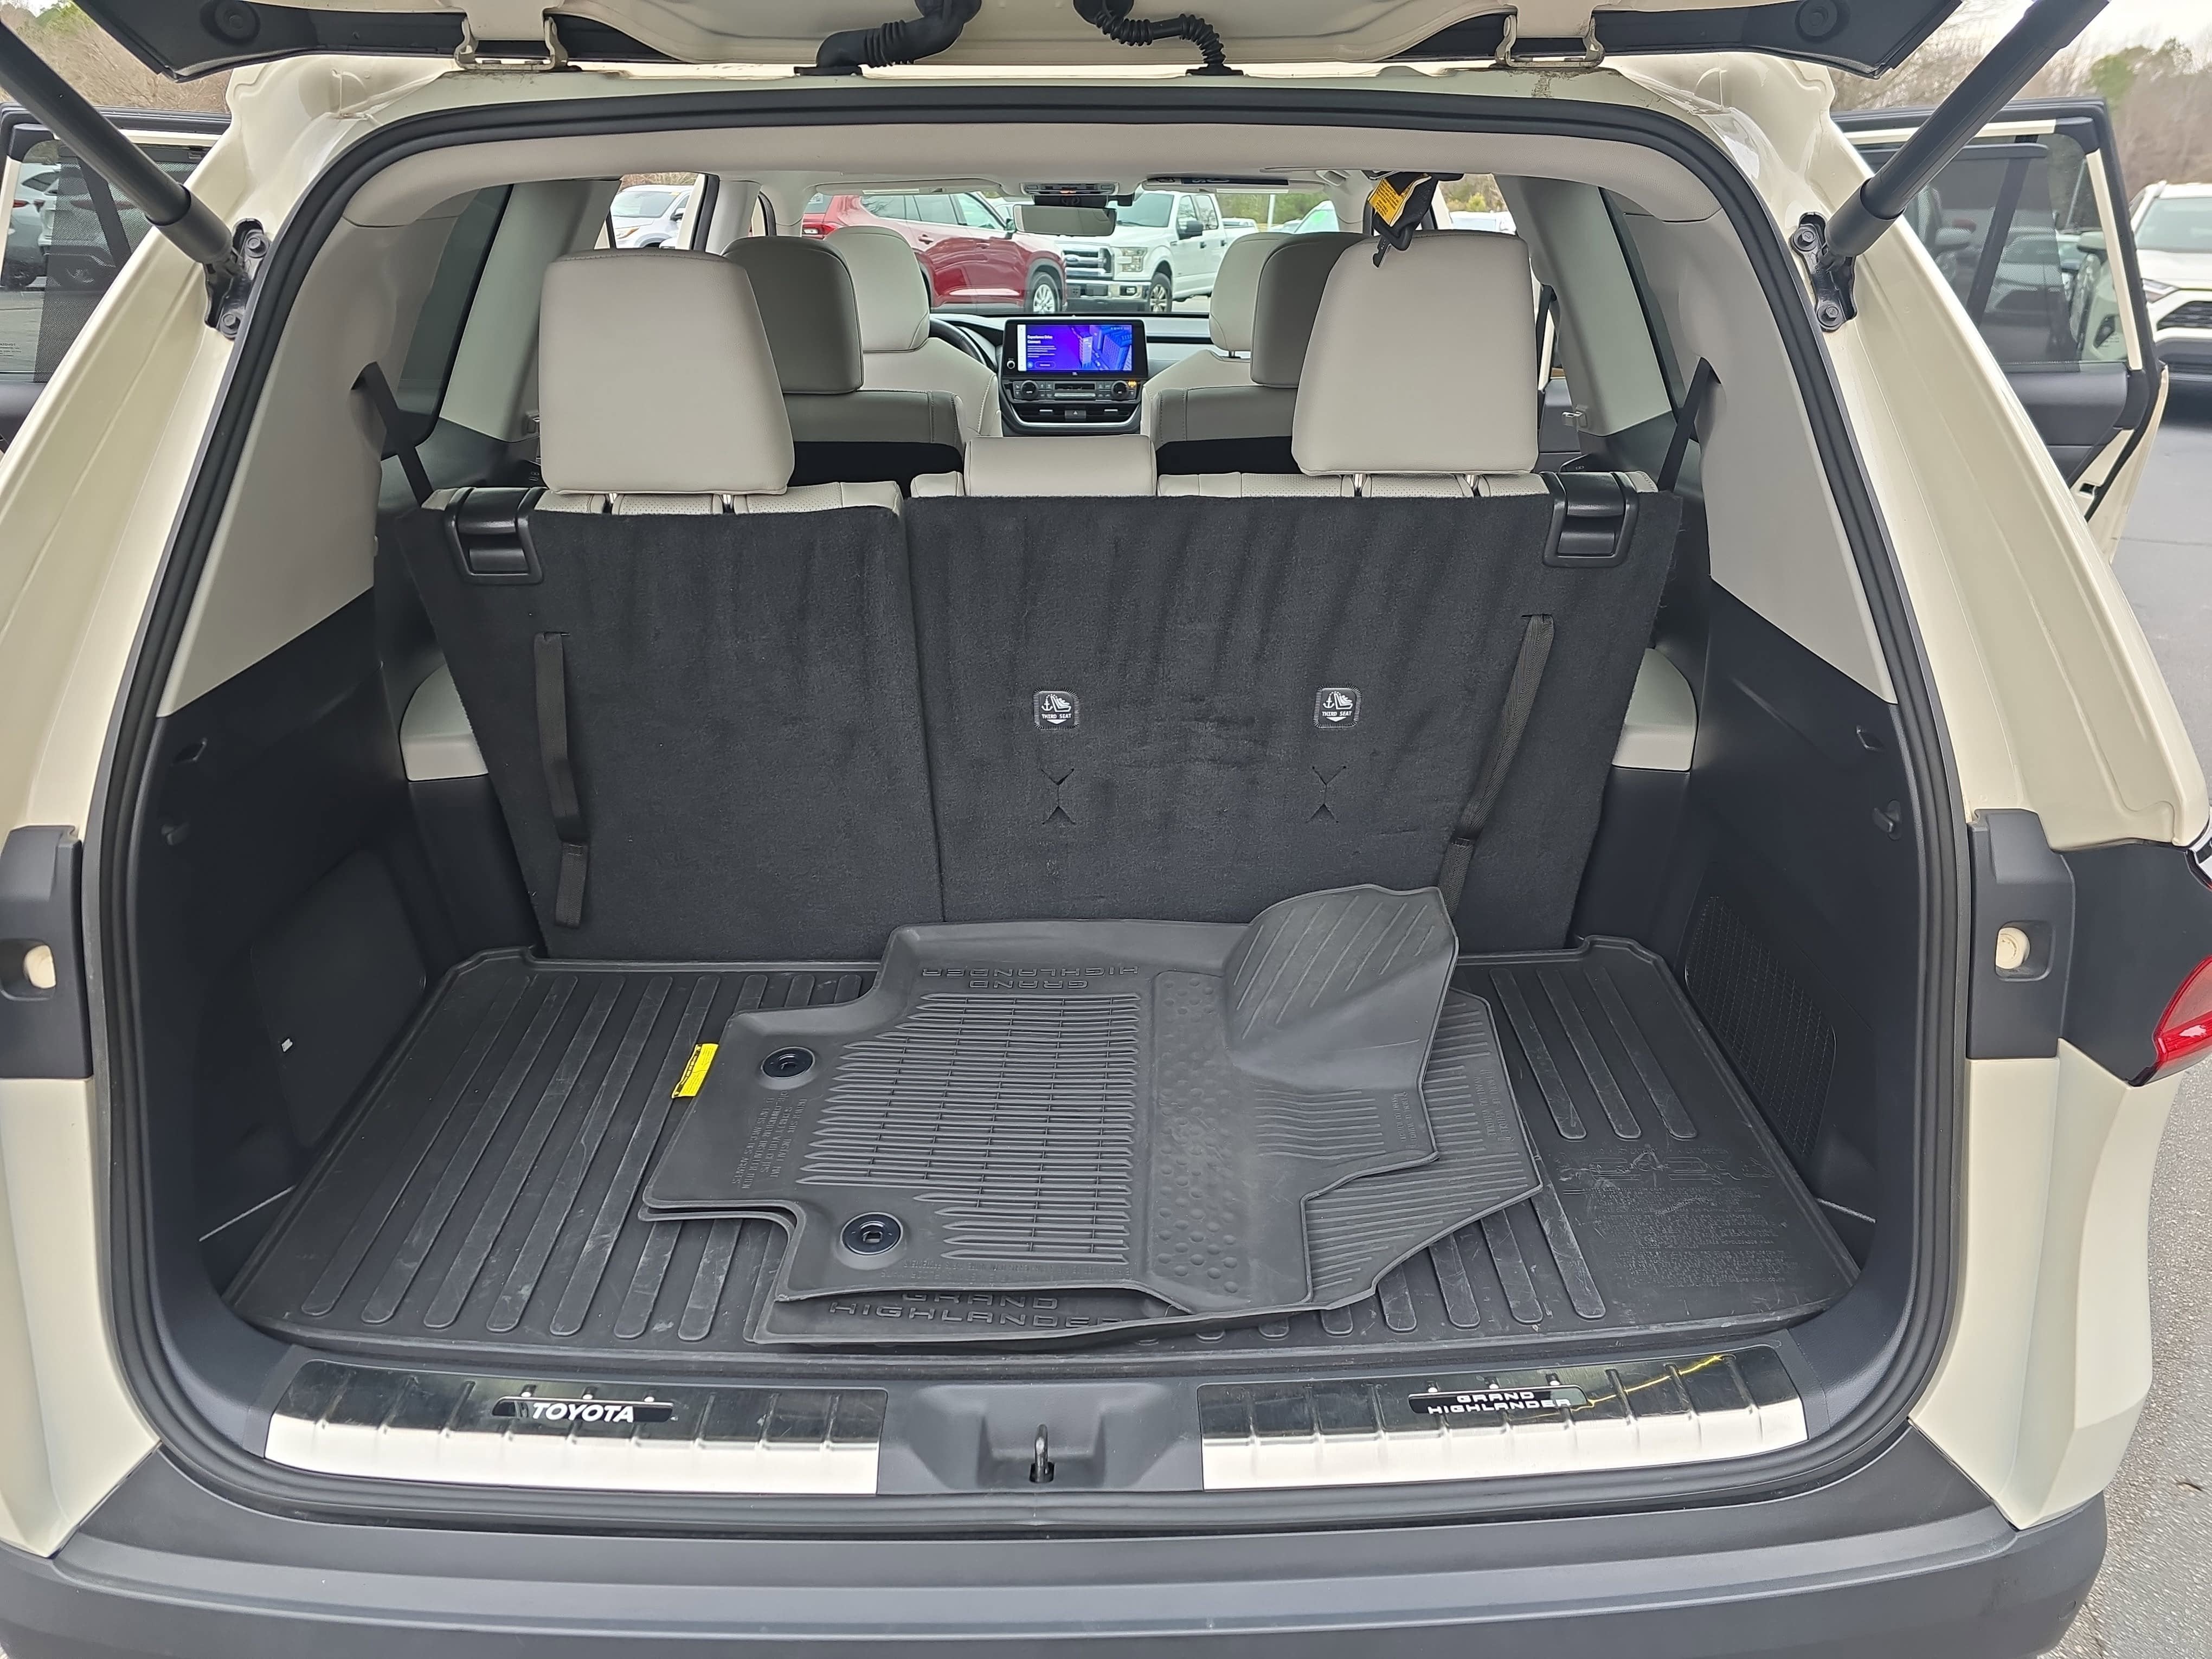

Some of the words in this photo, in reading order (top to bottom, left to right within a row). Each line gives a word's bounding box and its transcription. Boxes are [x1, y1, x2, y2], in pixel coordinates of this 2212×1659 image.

[922, 966, 1139, 976] HIGHLANDER
[968, 980, 1088, 989] GRAND
[902, 1293, 1058, 1310] GRAND
[1457, 1391, 1535, 1403] GRAND
[533, 1403, 634, 1423] TOYOTA
[1427, 1399, 1571, 1414] HIGHLANDER
